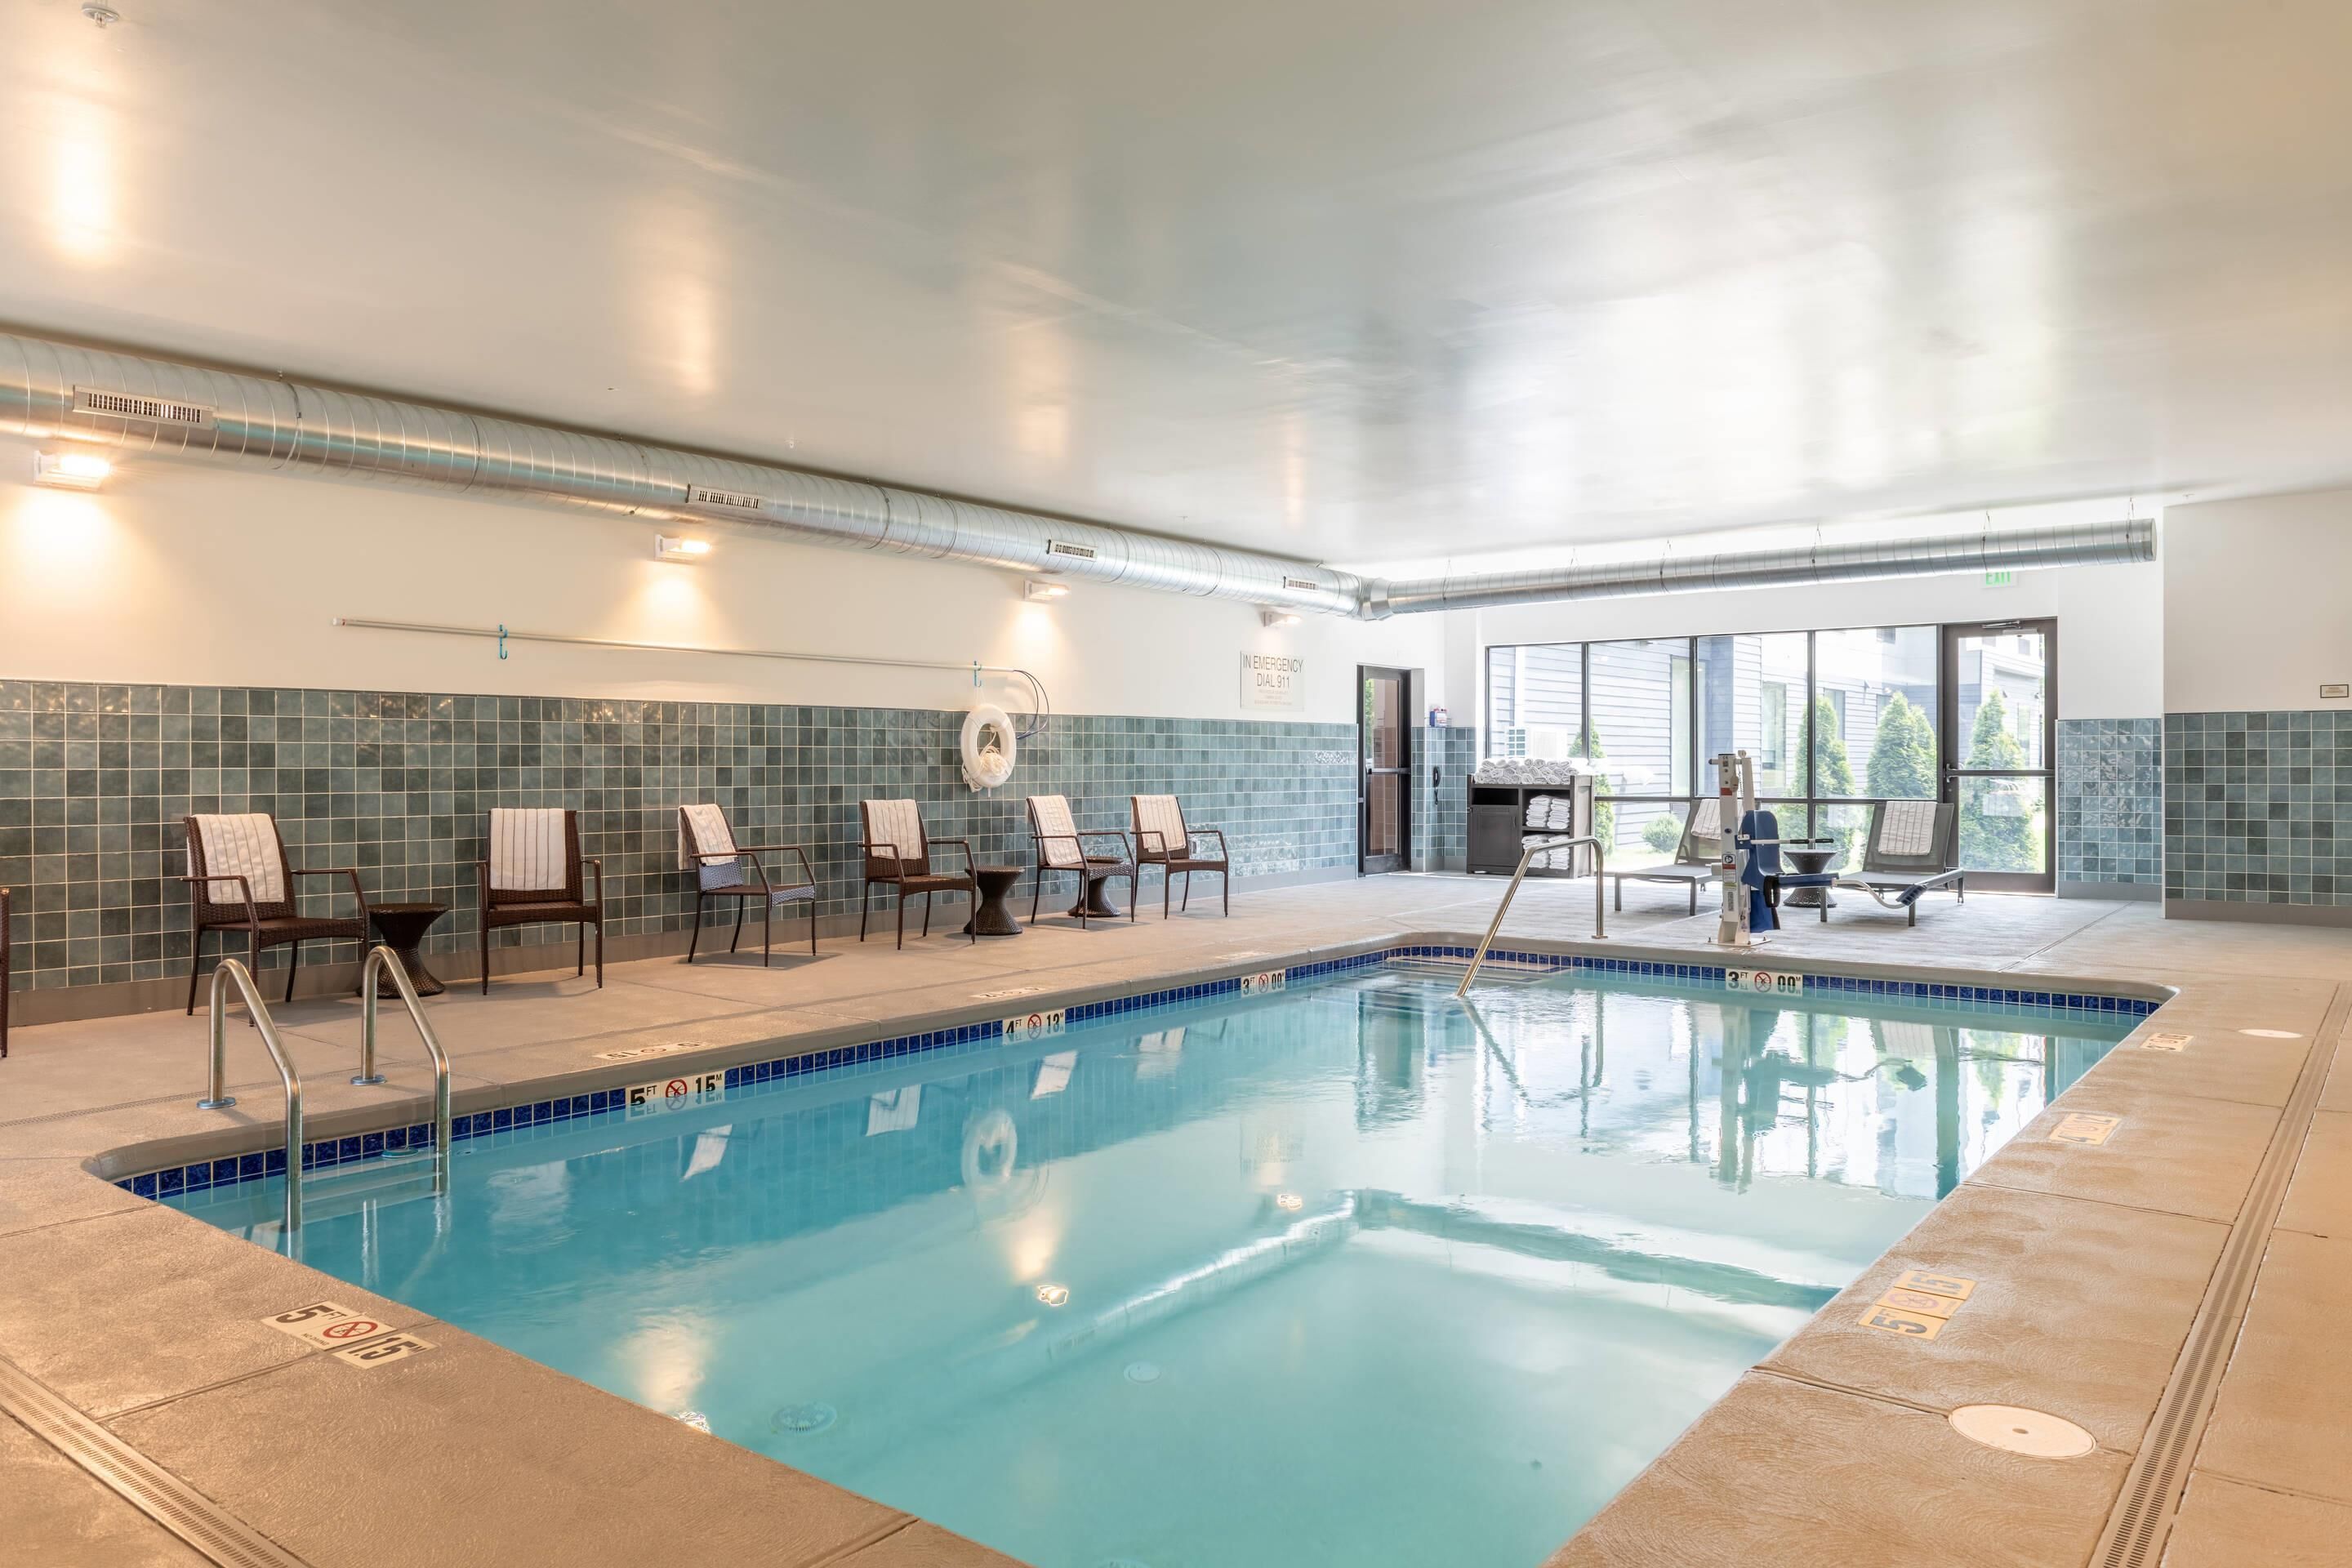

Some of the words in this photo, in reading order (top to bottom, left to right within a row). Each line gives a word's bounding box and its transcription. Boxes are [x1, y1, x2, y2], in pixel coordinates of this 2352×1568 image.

[1243, 654, 1251, 669] IN
[1254, 655, 1303, 673] EMERGENCY
[1257, 673, 1275, 688] DIAL
[1276, 675, 1290, 688] 911
